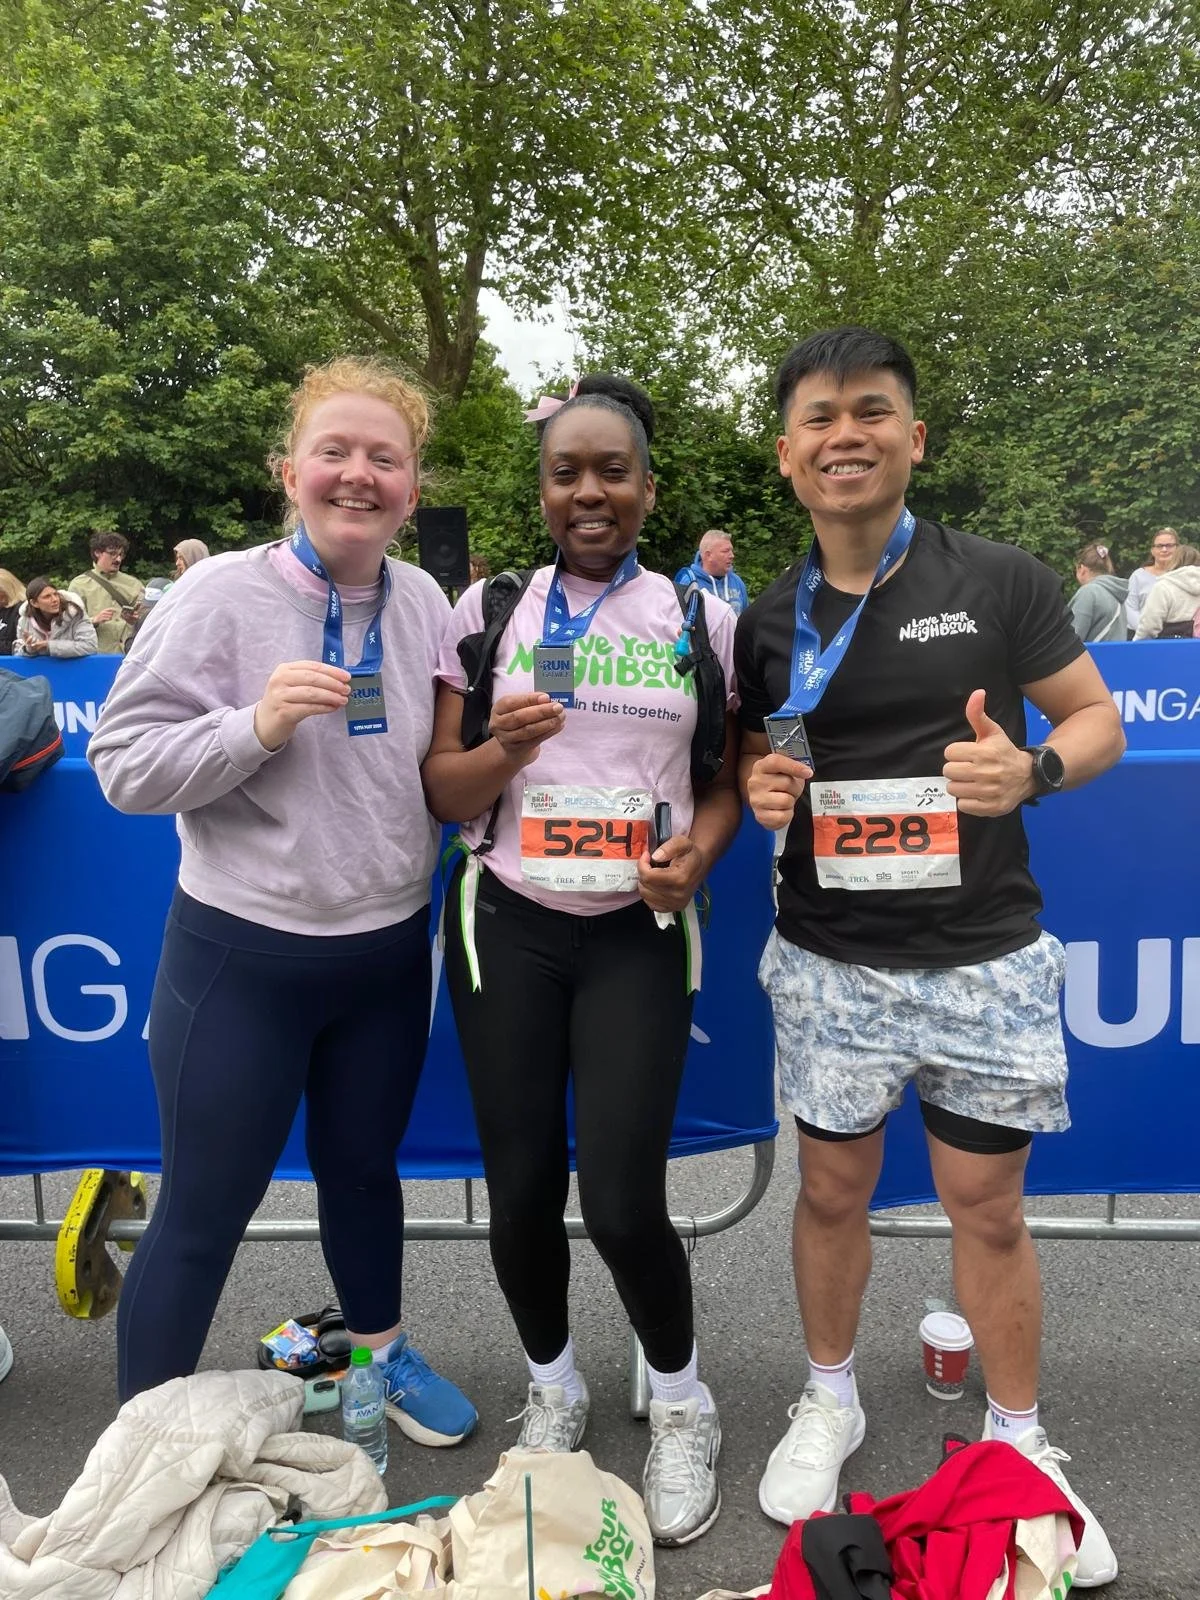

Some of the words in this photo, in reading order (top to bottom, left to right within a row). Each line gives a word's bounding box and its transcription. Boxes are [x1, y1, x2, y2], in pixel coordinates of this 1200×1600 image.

[329, 650, 337, 663] 5K
[543, 660, 570, 671] RUN
[353, 687, 381, 699] RUN
[592, 700, 619, 714] this
[622, 703, 682, 722] together
[543, 819, 633, 858] 524
[835, 815, 931, 855] 228
